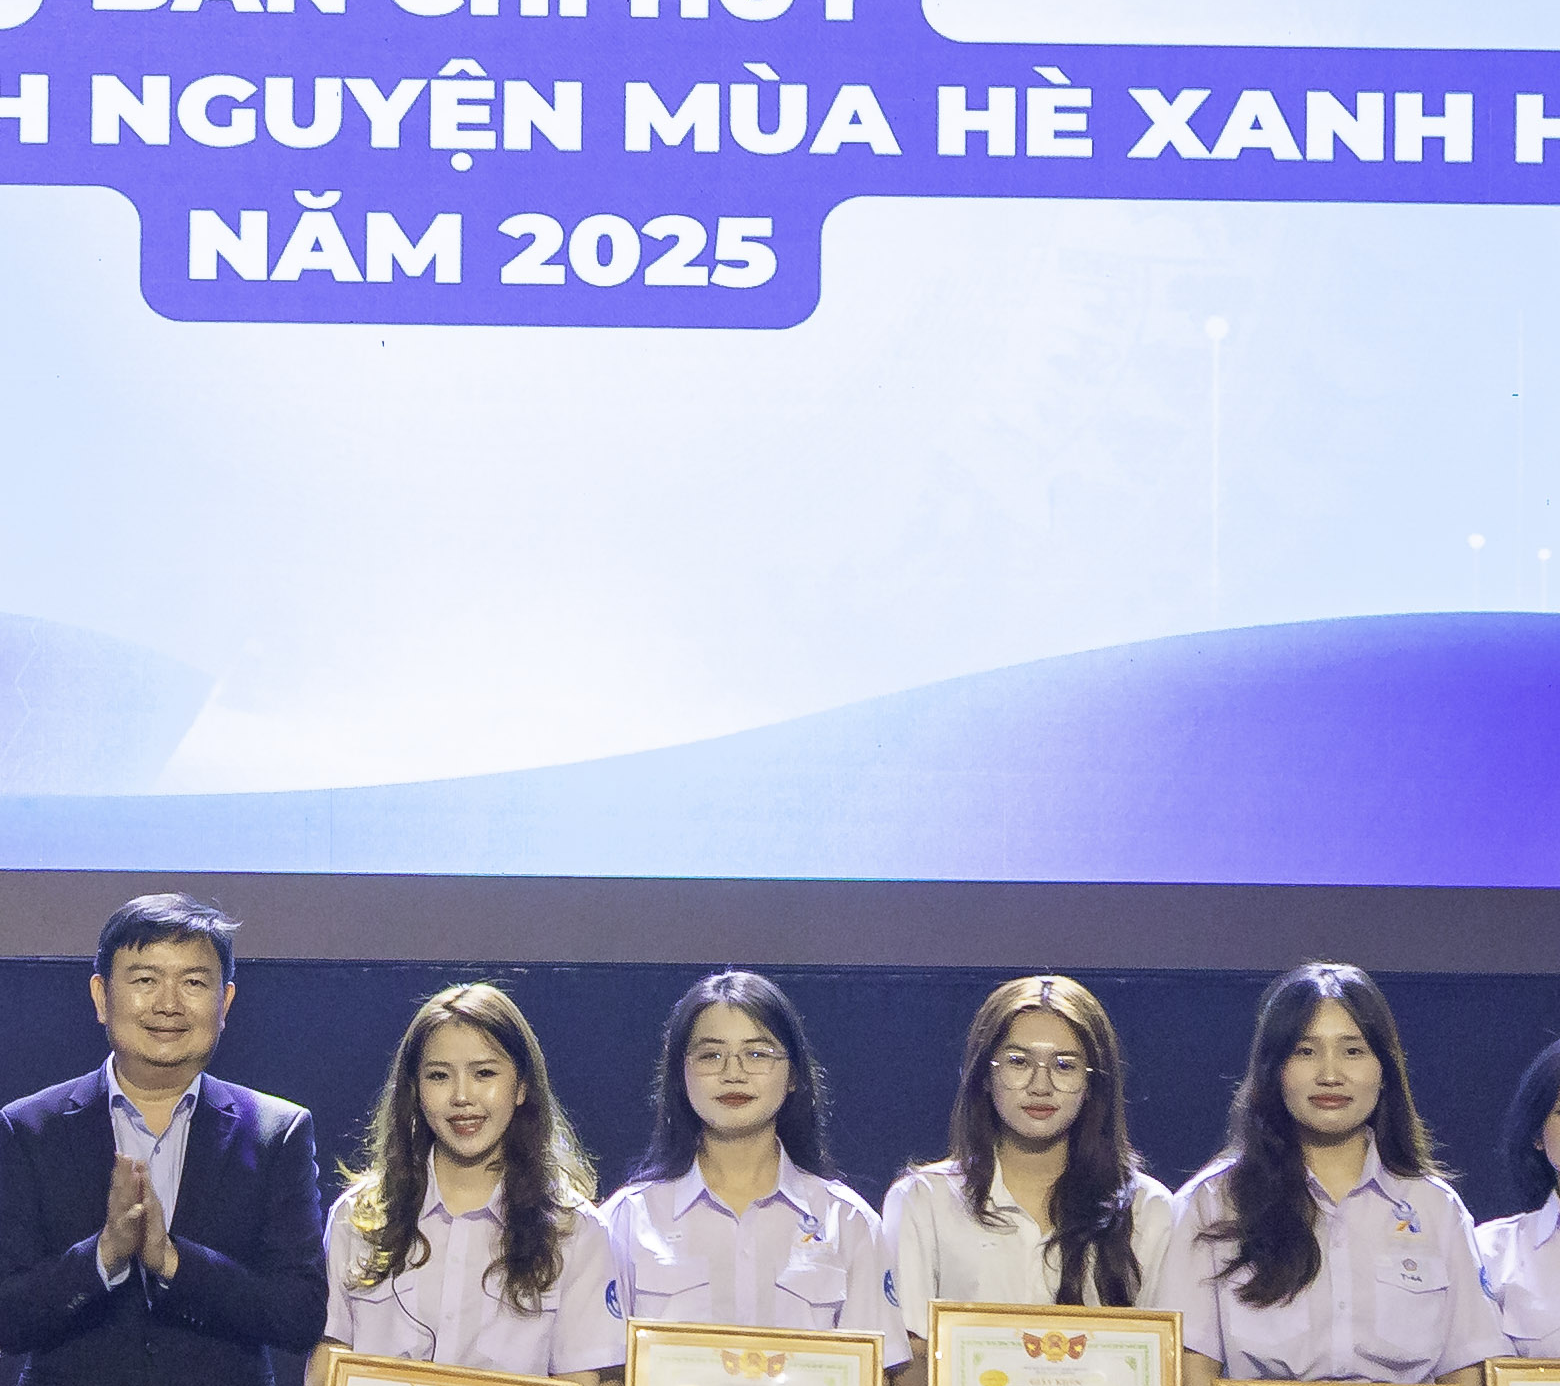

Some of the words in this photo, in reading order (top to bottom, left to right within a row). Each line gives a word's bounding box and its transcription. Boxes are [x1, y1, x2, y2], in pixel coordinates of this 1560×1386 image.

[90, 59, 583, 172] NGUYỆN
[624, 62, 902, 157] MÙA
[937, 66, 1093, 158] HÈ
[1127, 88, 1473, 163] XANH
[188, 190, 462, 284] NĂM
[498, 213, 777, 289] 2025
